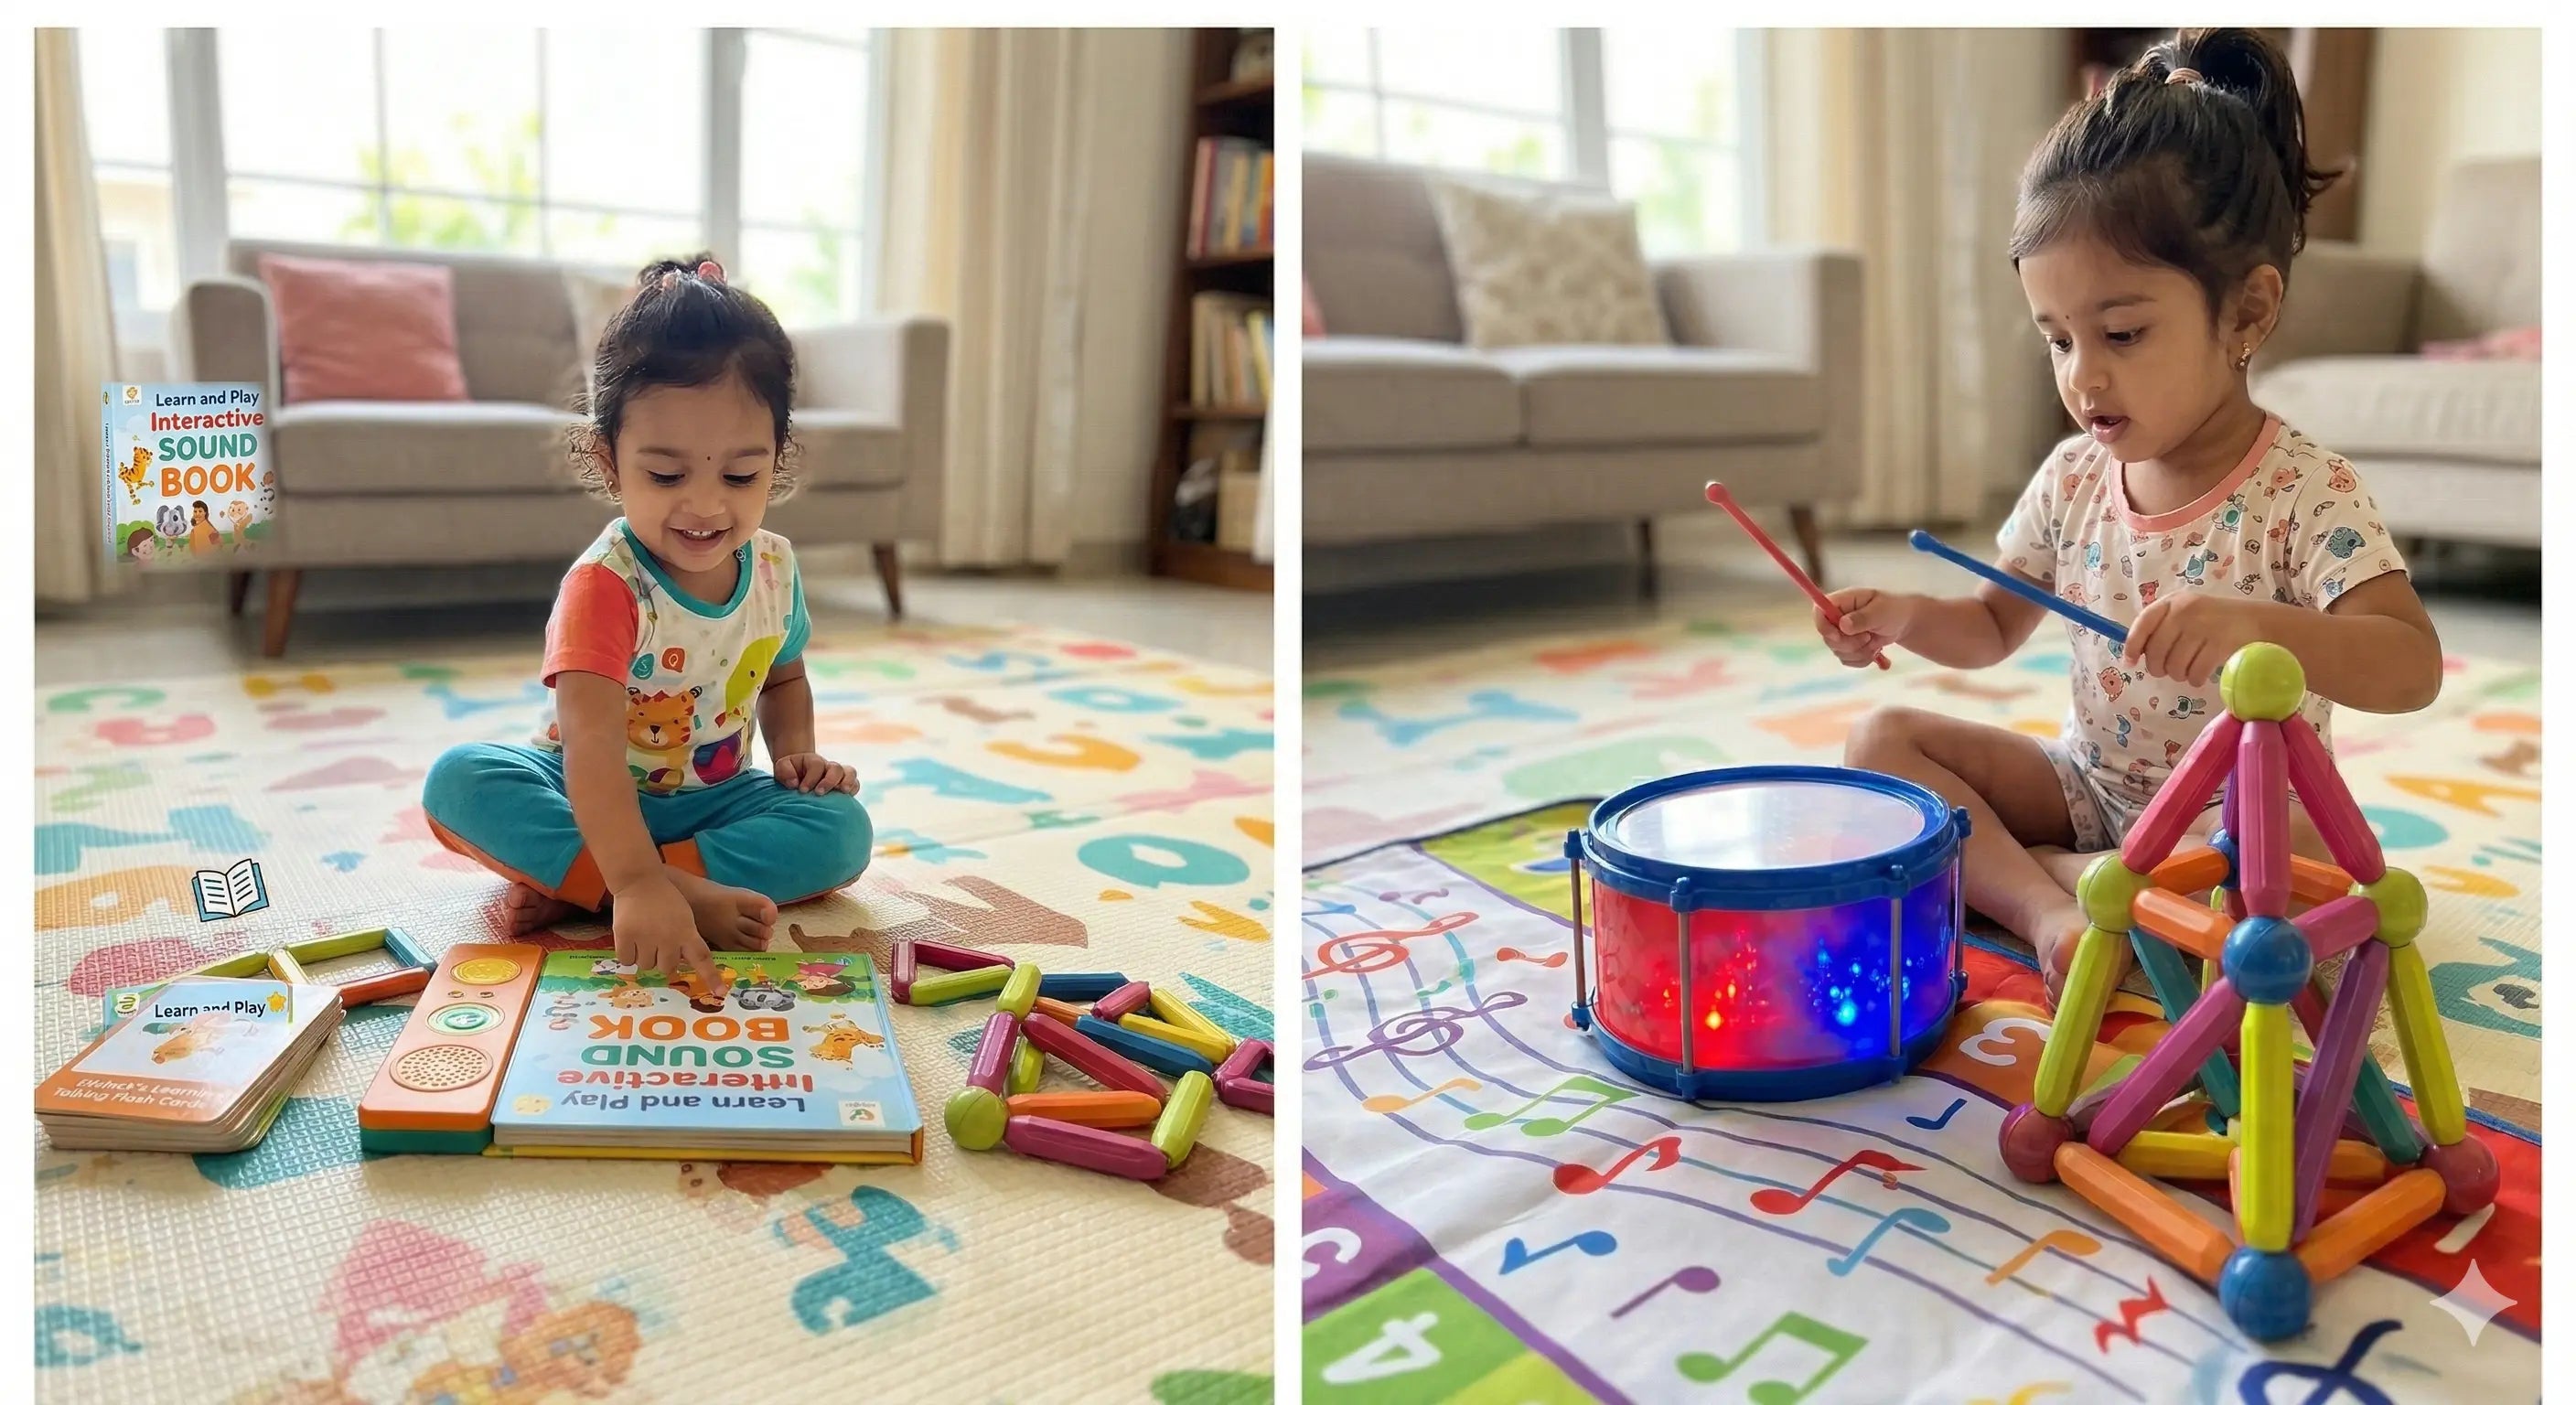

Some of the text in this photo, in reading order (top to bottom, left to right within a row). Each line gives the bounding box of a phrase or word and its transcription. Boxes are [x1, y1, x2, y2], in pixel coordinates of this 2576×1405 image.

[156, 390, 260, 407] Learn and Play
[151, 408, 264, 432] Interactive
[158, 433, 258, 462] SOUND
[161, 462, 256, 498] BOOK
[155, 1004, 199, 1018] Learn
[234, 1000, 266, 1018] Play
[587, 1014, 790, 1042] BOOK
[581, 1045, 795, 1068] SOUND
[561, 1089, 806, 1112] Learn and Play
